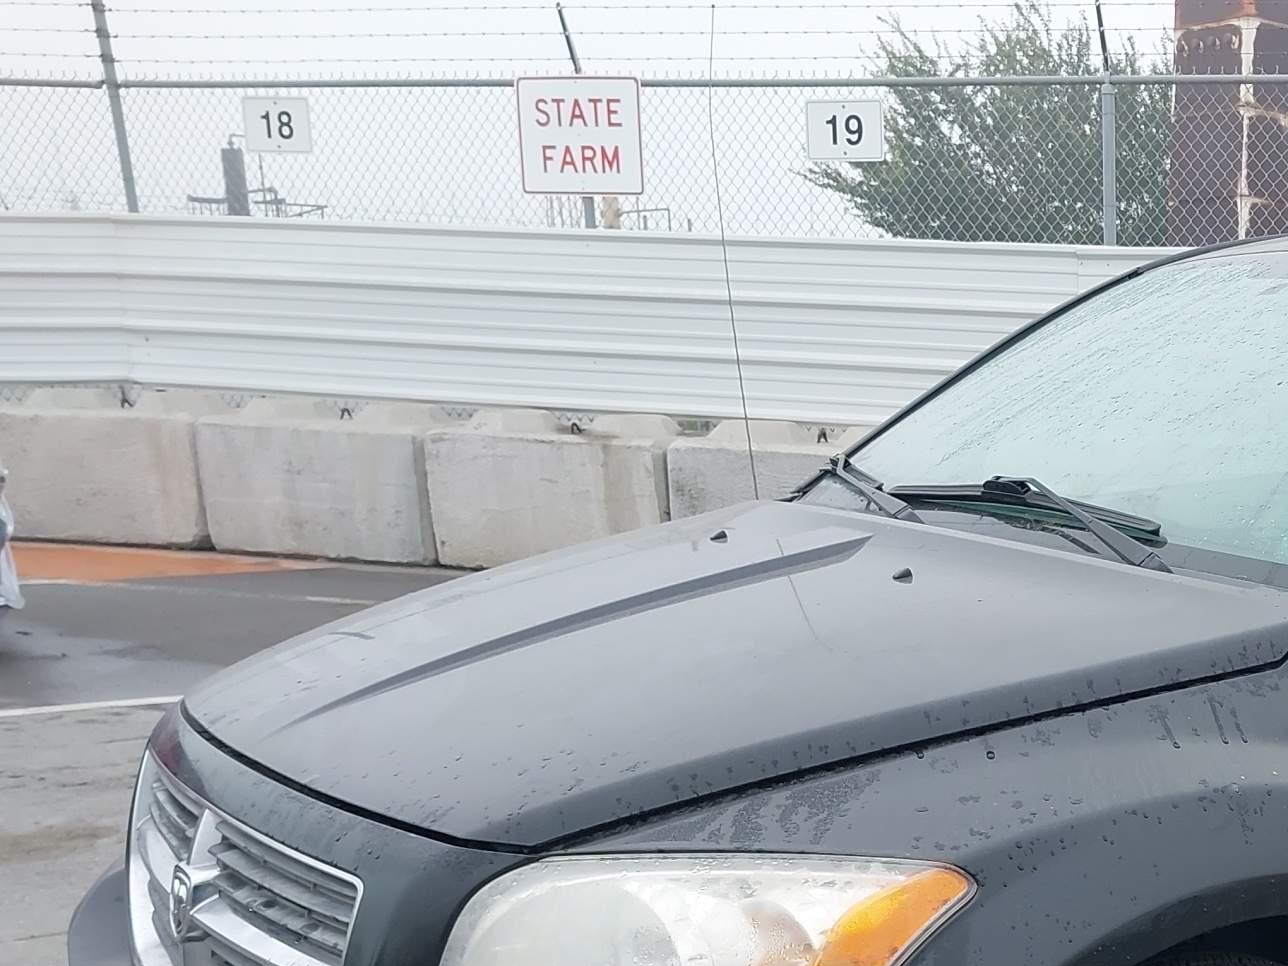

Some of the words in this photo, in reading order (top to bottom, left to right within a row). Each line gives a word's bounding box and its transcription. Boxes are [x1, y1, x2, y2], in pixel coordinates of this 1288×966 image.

[260, 110, 294, 140] 18
[535, 97, 623, 128] STATE
[825, 114, 864, 146] 19
[541, 145, 621, 174] FARM
